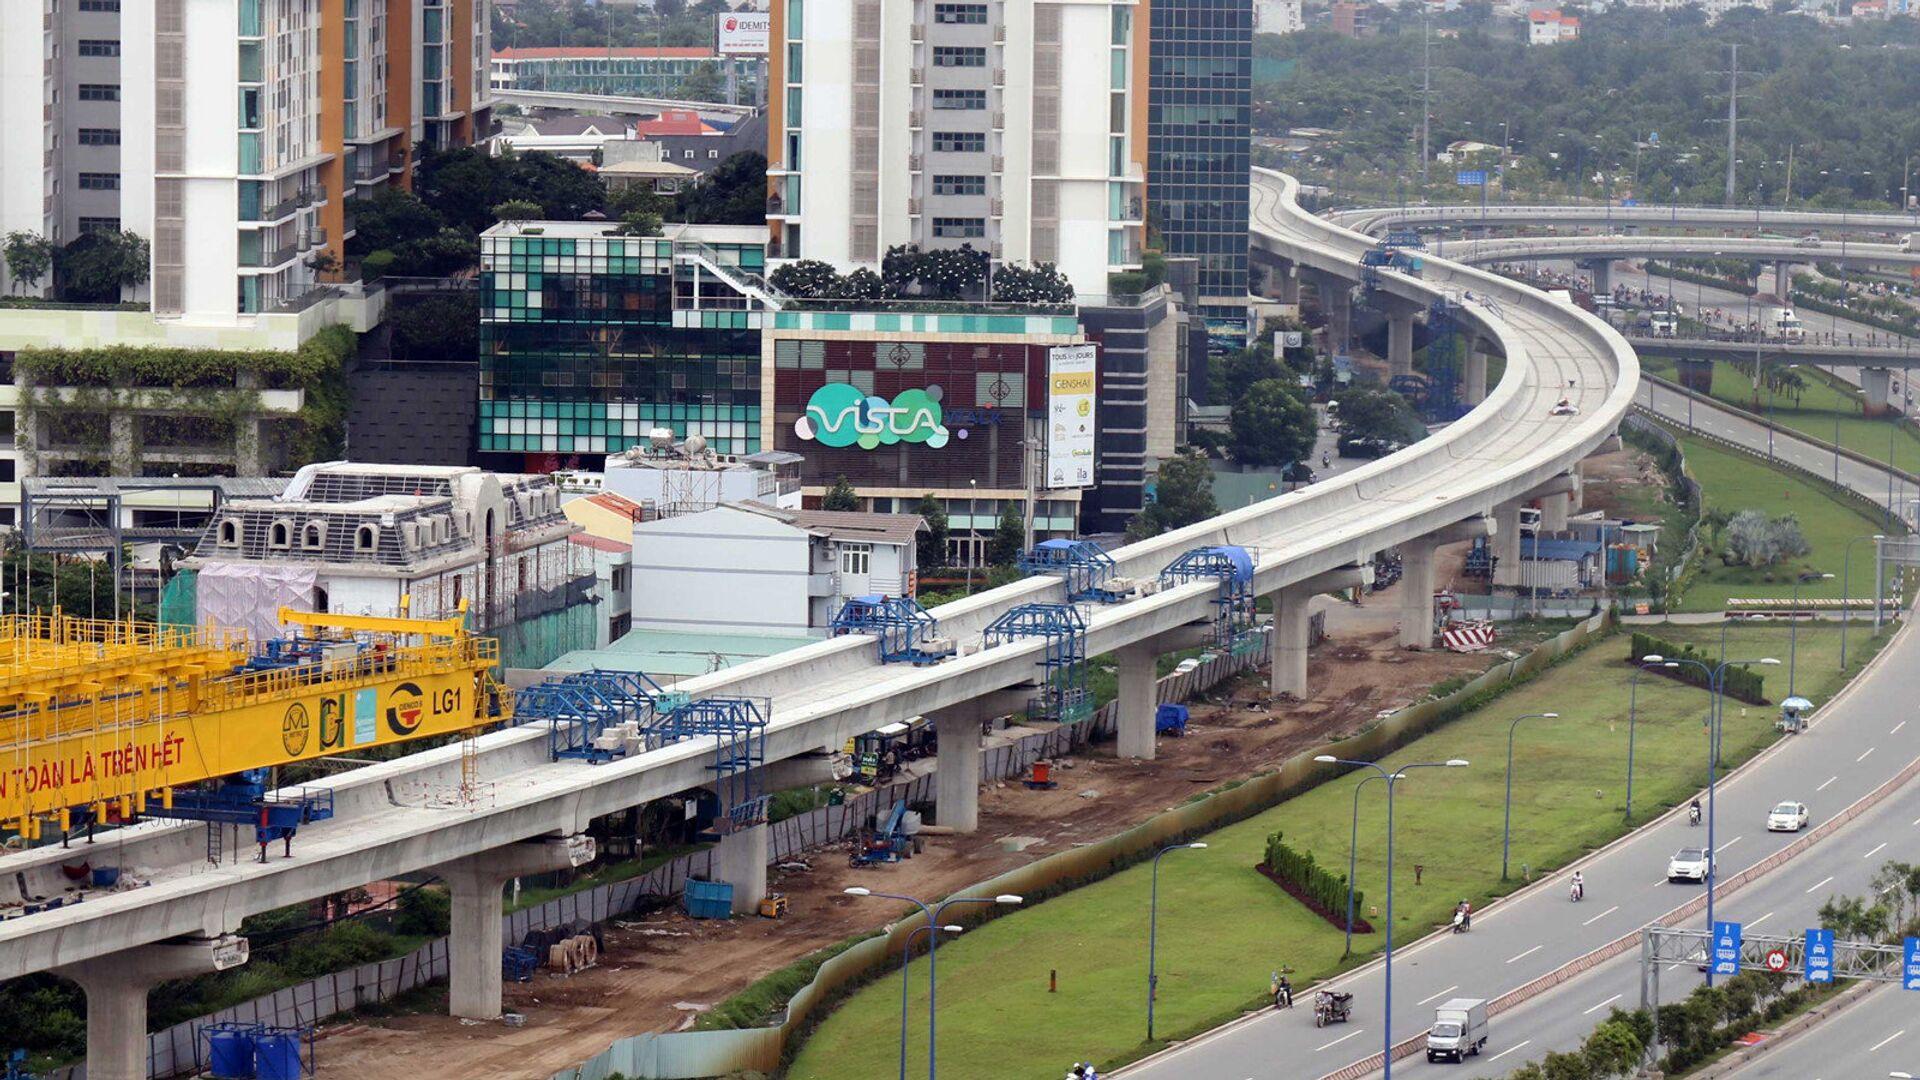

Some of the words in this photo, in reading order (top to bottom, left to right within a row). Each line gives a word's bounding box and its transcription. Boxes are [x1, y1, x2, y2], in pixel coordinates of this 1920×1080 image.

[433, 686, 461, 715] LG1
[12, 758, 64, 799] TOÀN
[70, 751, 95, 785] LÀ
[101, 742, 147, 778] TRÊN
[151, 731, 185, 769] HẾT
